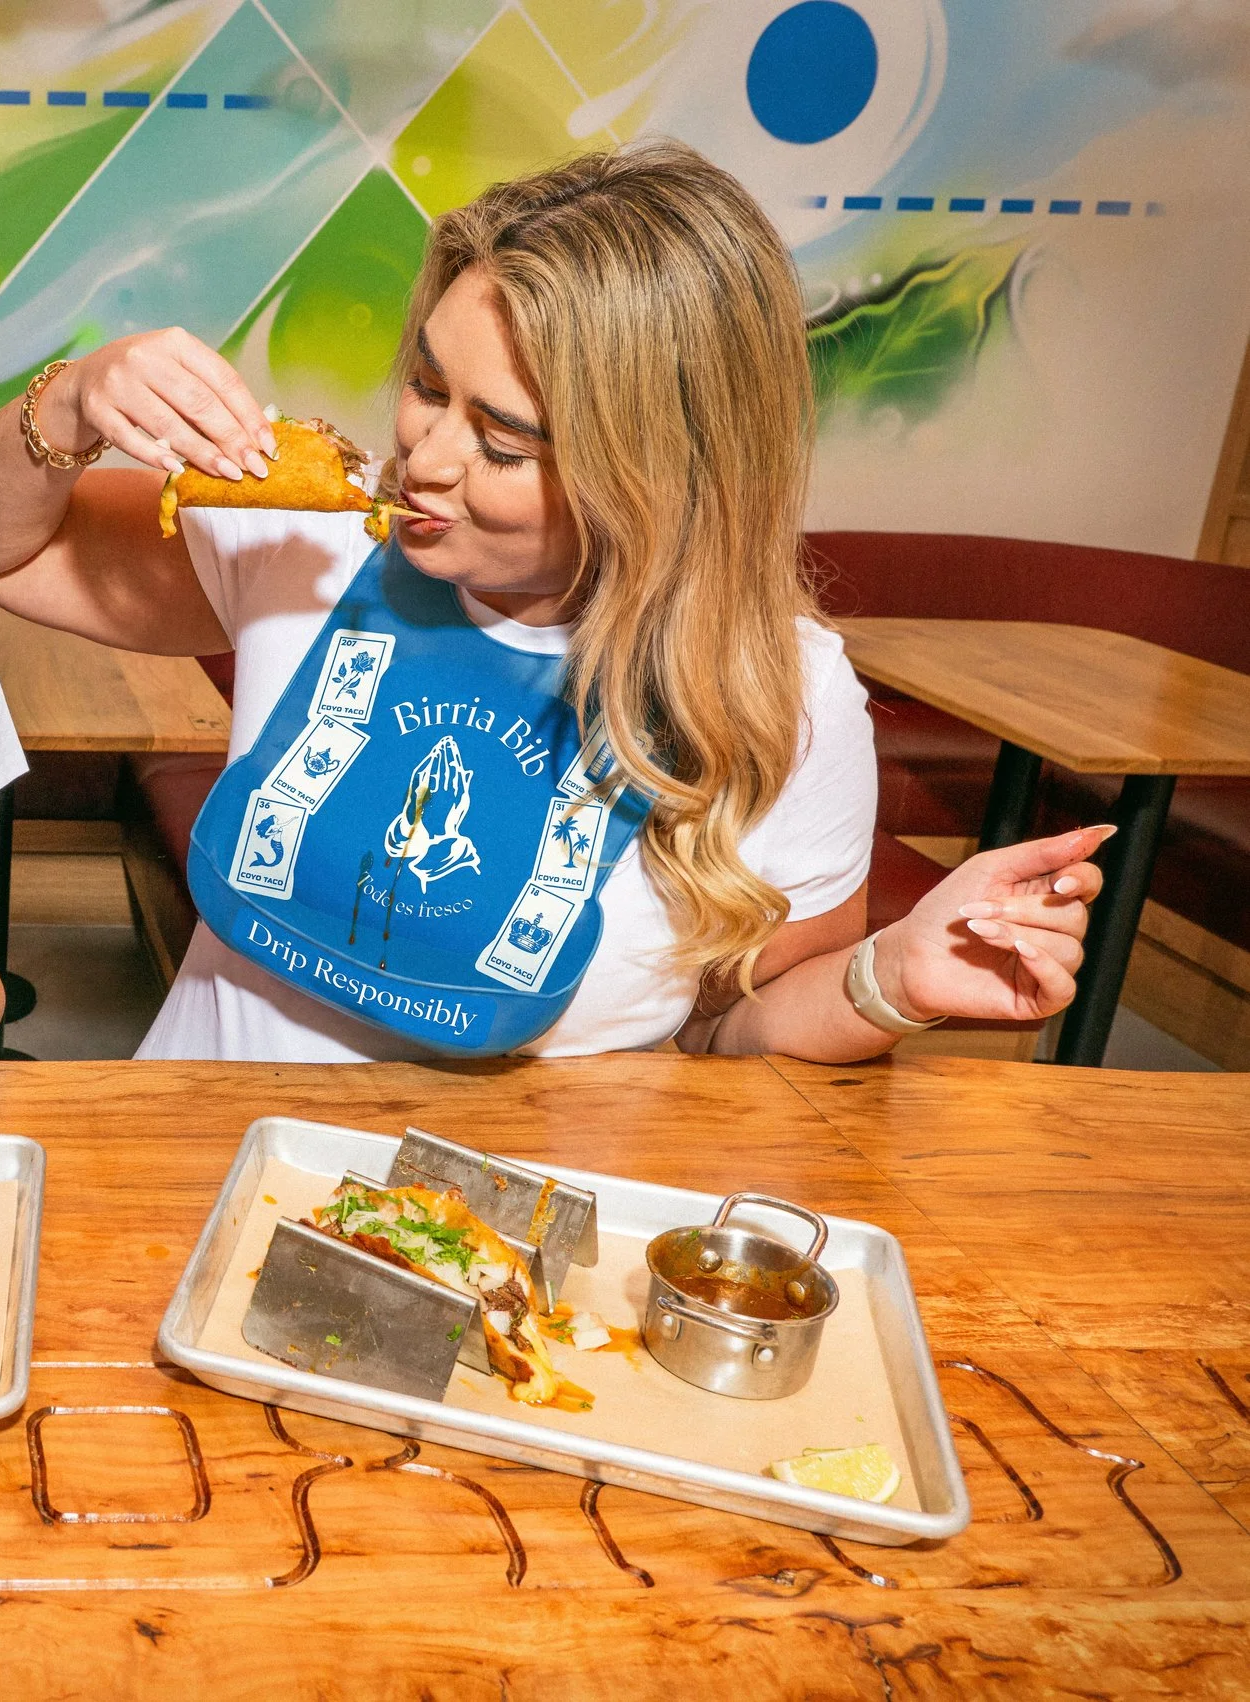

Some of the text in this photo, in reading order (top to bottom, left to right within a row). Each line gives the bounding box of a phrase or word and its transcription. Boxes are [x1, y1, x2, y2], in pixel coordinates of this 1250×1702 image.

[340, 639, 357, 647] 207
[320, 704, 365, 715] COYO TACO
[323, 718, 334, 729] 06
[390, 696, 550, 777] Birria Bib
[276, 779, 316, 805] COYO TACO
[565, 779, 585, 793] COYO
[258, 800, 270, 809] 36
[555, 803, 565, 811] 31
[240, 871, 284, 886] COYO TACO
[537, 874, 583, 886] COYO TACO
[530, 887, 540, 897] 18
[395, 901, 414, 916] es
[418, 899, 473, 918] fresco
[490, 956, 533, 980] COYO TACO
[246, 920, 478, 1036] Drip Responsibly
